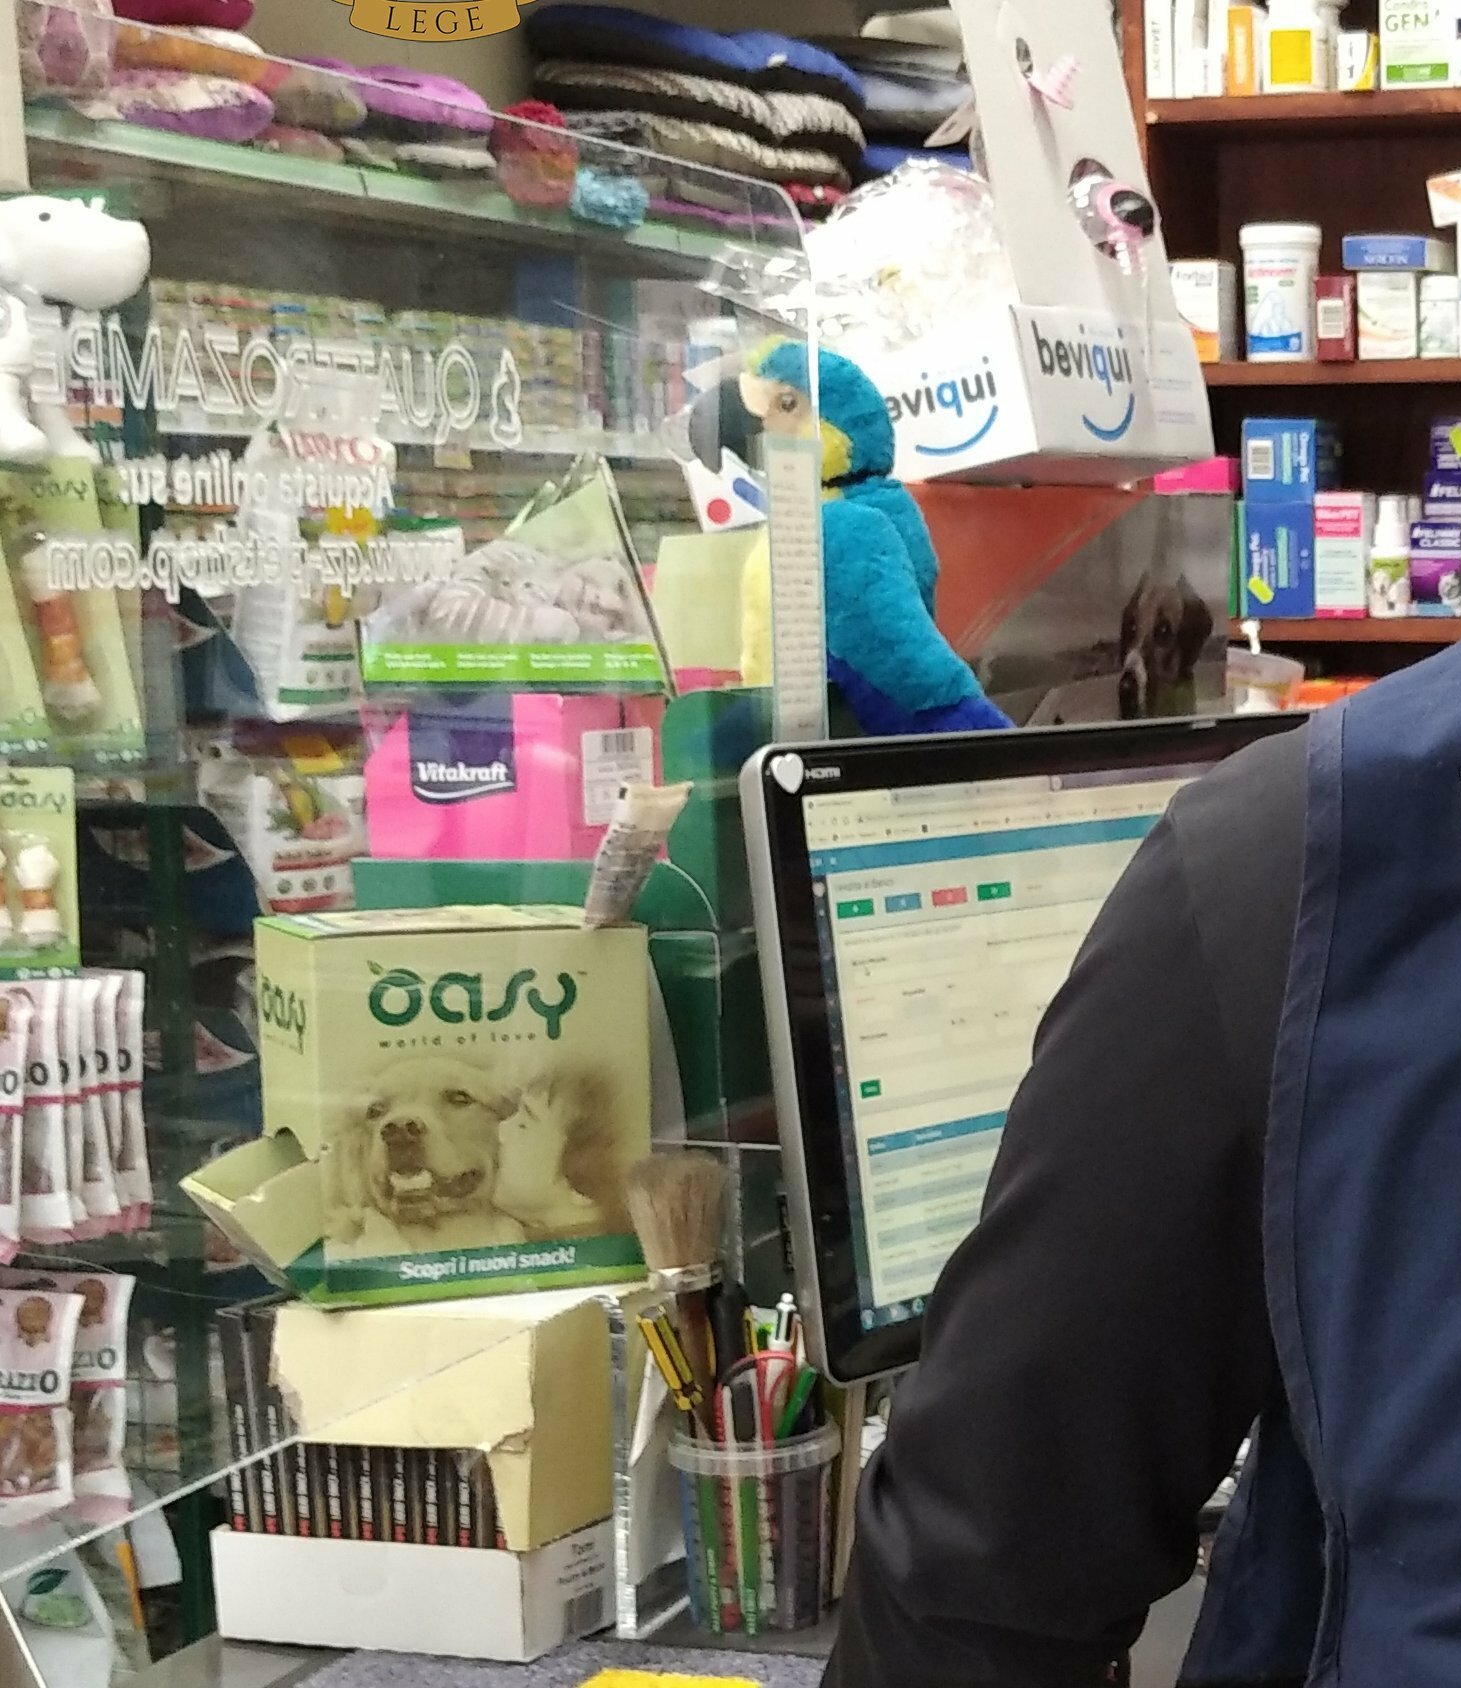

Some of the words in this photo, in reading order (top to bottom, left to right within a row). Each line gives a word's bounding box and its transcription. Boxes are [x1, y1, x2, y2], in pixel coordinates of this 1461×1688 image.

[1031, 319, 1134, 396] beviqui
[885, 356, 998, 423] eviqui
[416, 761, 509, 784] Vitakraft
[379, 1031, 443, 1048] world
[456, 1032, 478, 1046] of
[491, 1030, 537, 1044] love
[399, 1256, 458, 1281] Scopri
[459, 1255, 467, 1274] i
[469, 1250, 516, 1274] nuovi
[518, 1245, 576, 1268] snack!
